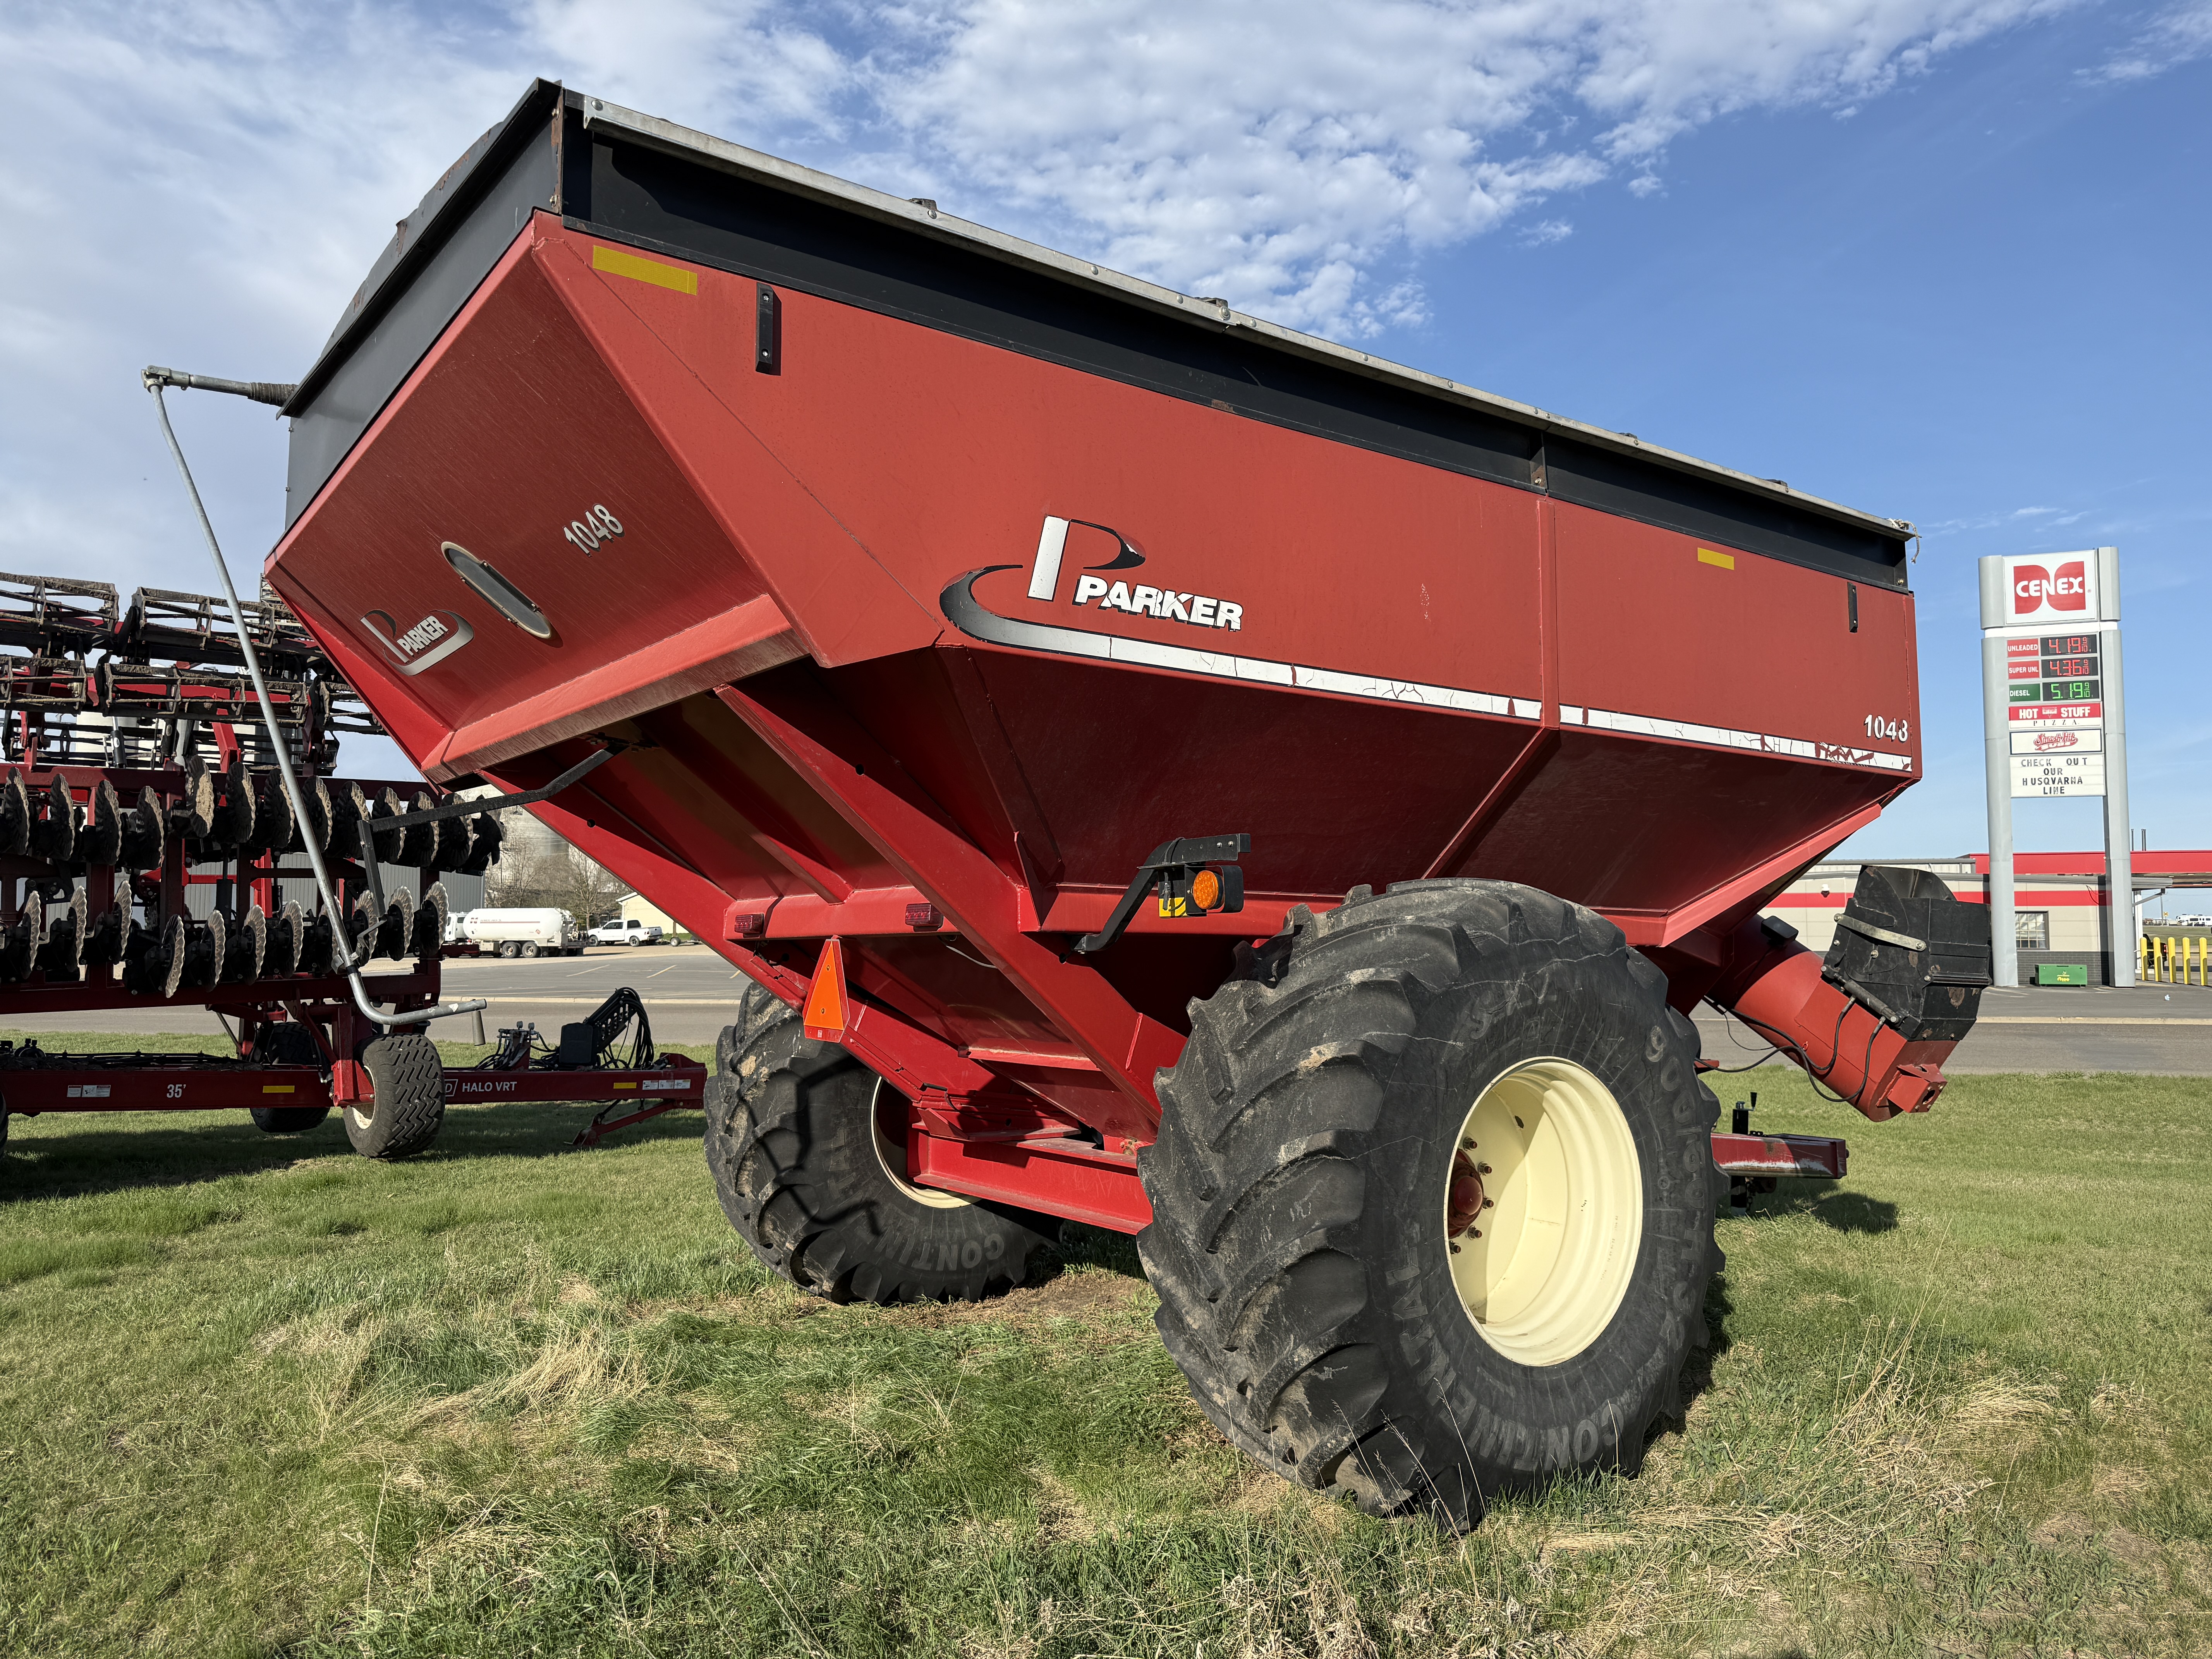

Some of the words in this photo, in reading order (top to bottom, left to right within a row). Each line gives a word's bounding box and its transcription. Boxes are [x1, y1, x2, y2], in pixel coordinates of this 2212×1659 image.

[563, 503, 624, 557] 1048
[2016, 577, 2083, 598] CENEX
[1073, 575, 1243, 631] PARKER
[397, 615, 449, 657] PARKER
[2049, 638, 2081, 654] 4.19
[2051, 682, 2083, 699] 5.19
[2019, 708, 2039, 719] HOT
[2061, 706, 2091, 718] STUFF
[2021, 758, 2052, 767] CHECK
[2066, 757, 2087, 766] OUT
[2043, 768, 2063, 776] OUR
[2023, 776, 2083, 786] HUSQVARNA
[2043, 786, 2065, 795] LINE
[462, 1082, 493, 1092] HALO
[495, 1081, 517, 1091] VRT
[1385, 1247, 1624, 1471] CONTINENTAL
